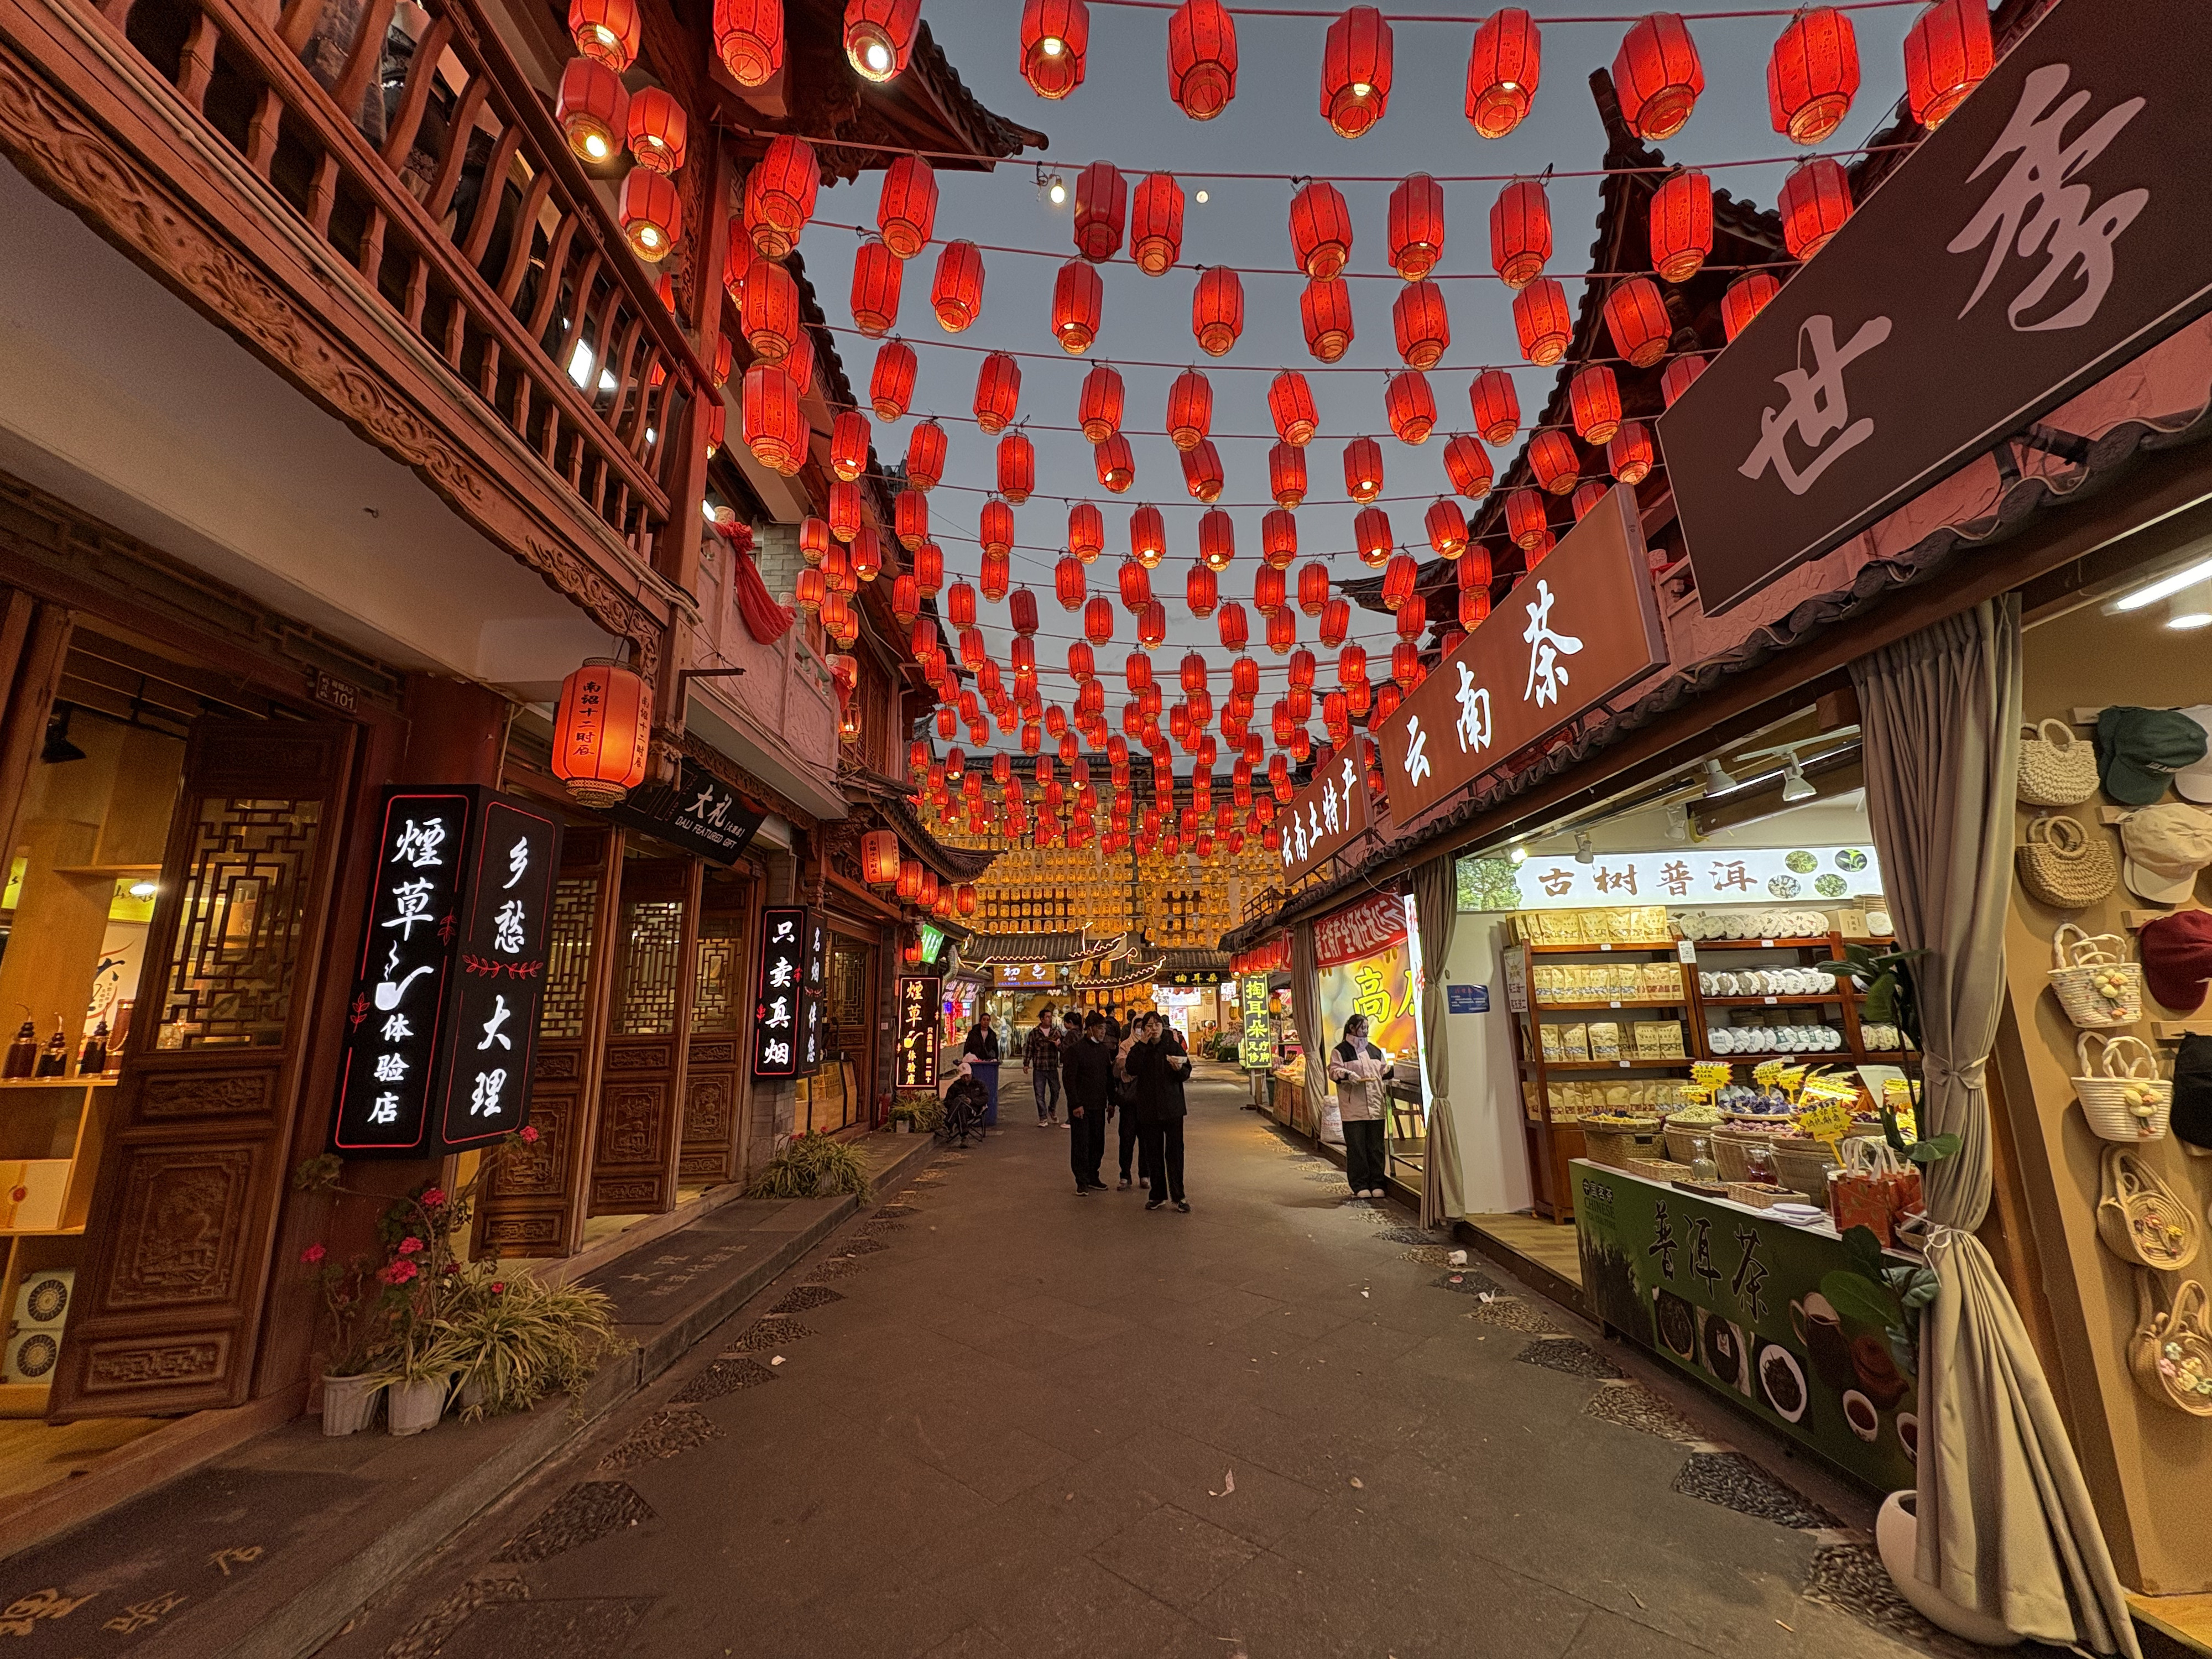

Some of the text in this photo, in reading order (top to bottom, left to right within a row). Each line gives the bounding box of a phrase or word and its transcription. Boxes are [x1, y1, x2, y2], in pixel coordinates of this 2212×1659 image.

[332, 690, 354, 709] 101
[1404, 579, 1583, 787] 云南茶
[572, 681, 601, 755] 南诏十二时辰
[685, 784, 733, 827] 大礼
[1282, 758, 1357, 868] 云南土特产
[674, 816, 737, 849] DALI FEATURED GIFT
[1538, 859, 1758, 897] 古树普洱
[763, 921, 795, 1065] 只卖真烟
[1175, 972, 1218, 983] 掏耳朵
[1245, 980, 1268, 1039] 掏耳朵
[1248, 1040, 1270, 1051] 足疗
[1248, 1052, 1270, 1063] 修脚
[1584, 1197, 1615, 1219] CHINESE
[1648, 1200, 1769, 1322] 普洱茶
